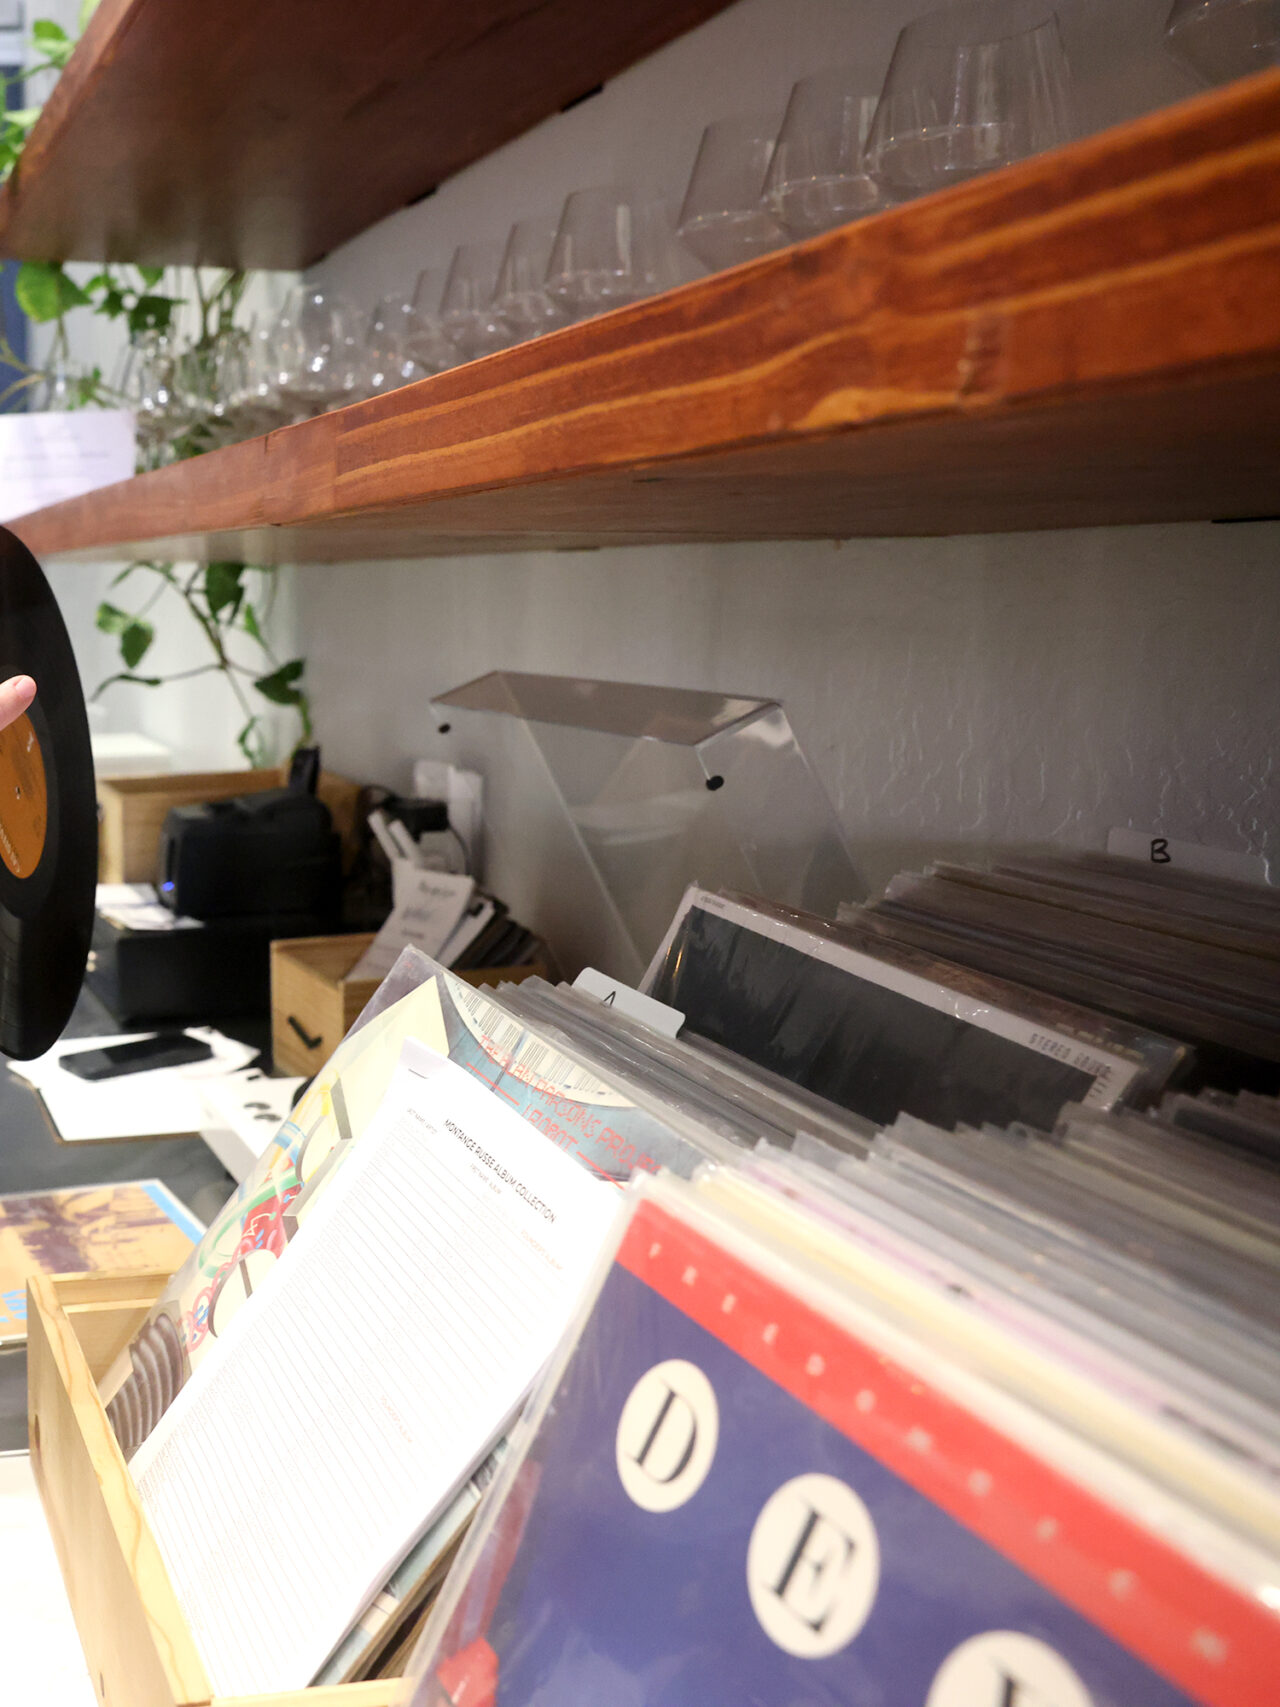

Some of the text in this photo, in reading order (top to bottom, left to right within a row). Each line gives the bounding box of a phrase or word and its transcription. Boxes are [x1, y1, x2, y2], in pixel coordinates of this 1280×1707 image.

[1150, 838, 1171, 863] B
[499, 1053, 536, 1088] ALAN
[532, 1078, 602, 1139] PARSONS
[527, 1108, 579, 1153] ROBOT
[474, 1145, 496, 1169] RUSSE
[493, 1163, 518, 1189] ALBUM
[515, 1182, 557, 1224] COLLECTION
